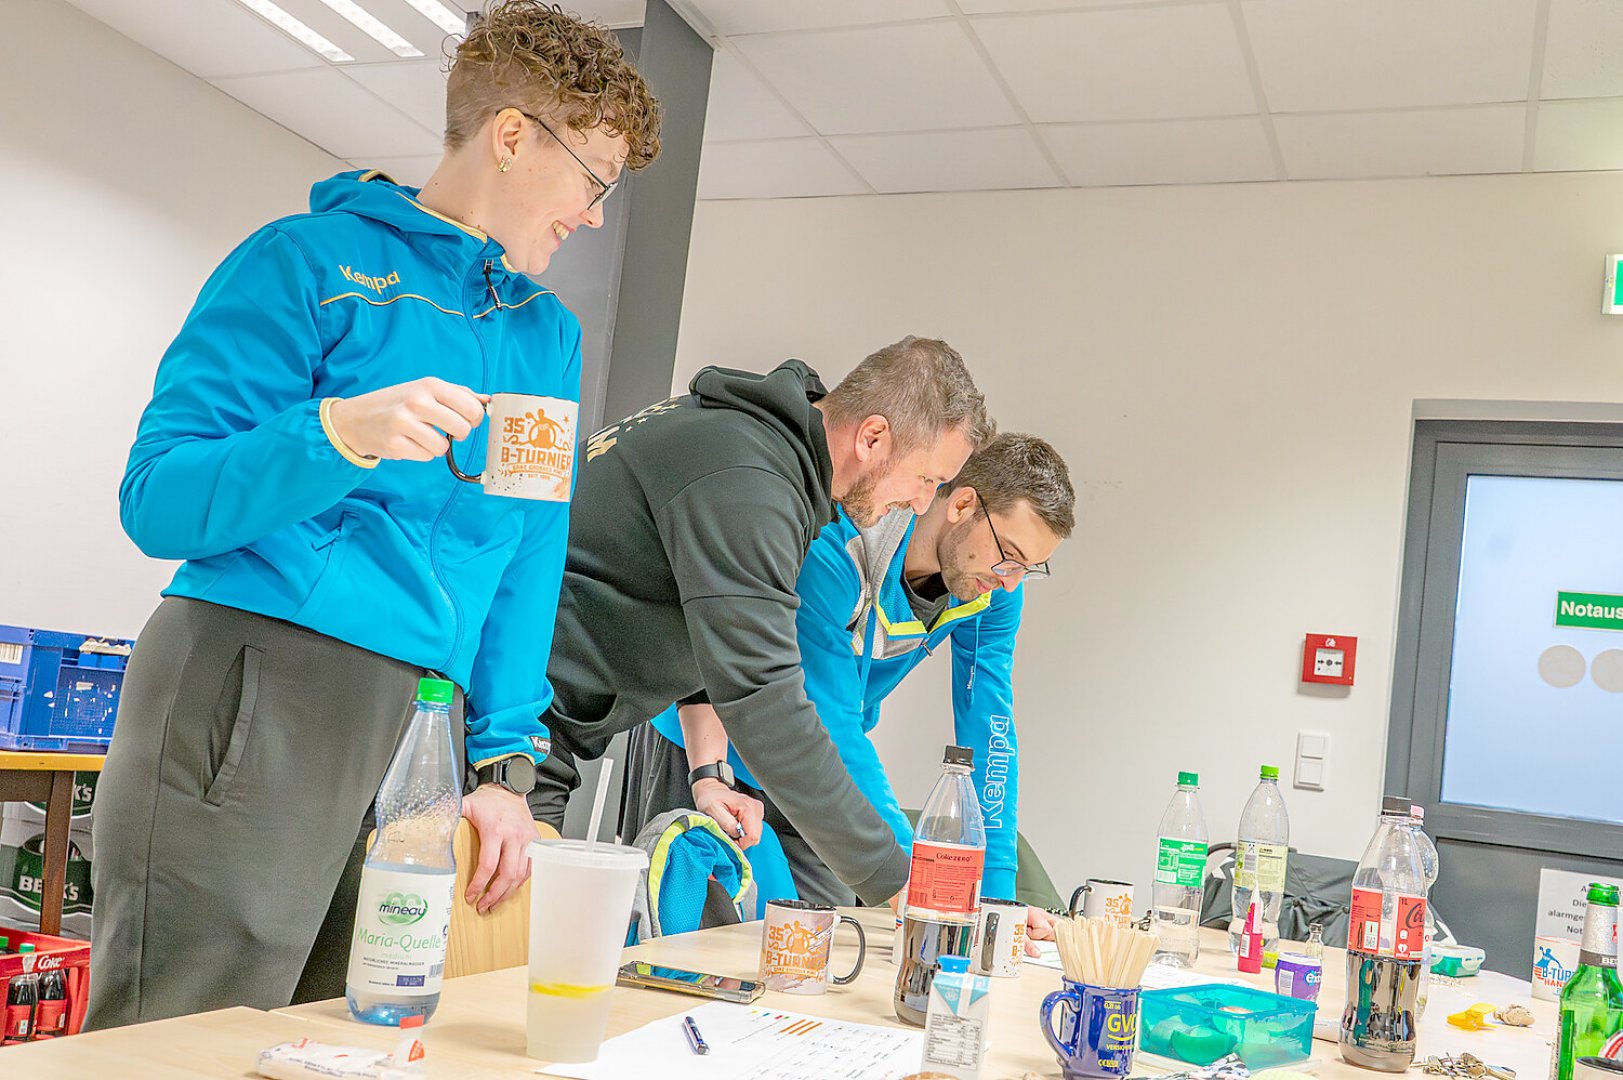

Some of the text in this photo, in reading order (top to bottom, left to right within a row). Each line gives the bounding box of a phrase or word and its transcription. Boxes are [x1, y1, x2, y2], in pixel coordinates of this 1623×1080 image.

[339, 264, 401, 295] Kempa
[503, 416, 525, 434] 35
[501, 446, 572, 470] B-TURNIER
[1561, 600, 1623, 620] Notaus
[975, 714, 1016, 829] Kempa
[73, 783, 93, 802] K'S
[19, 874, 80, 901] BEK'S
[378, 902, 427, 916] mineau
[1548, 909, 1584, 922] alarmge
[768, 925, 785, 942] 35
[1566, 925, 1583, 935] Not
[359, 927, 442, 952] Maria-Quelle
[38, 955, 62, 970] Coke
[1542, 967, 1574, 981] B-TUR
[1544, 978, 1564, 988] HAN
